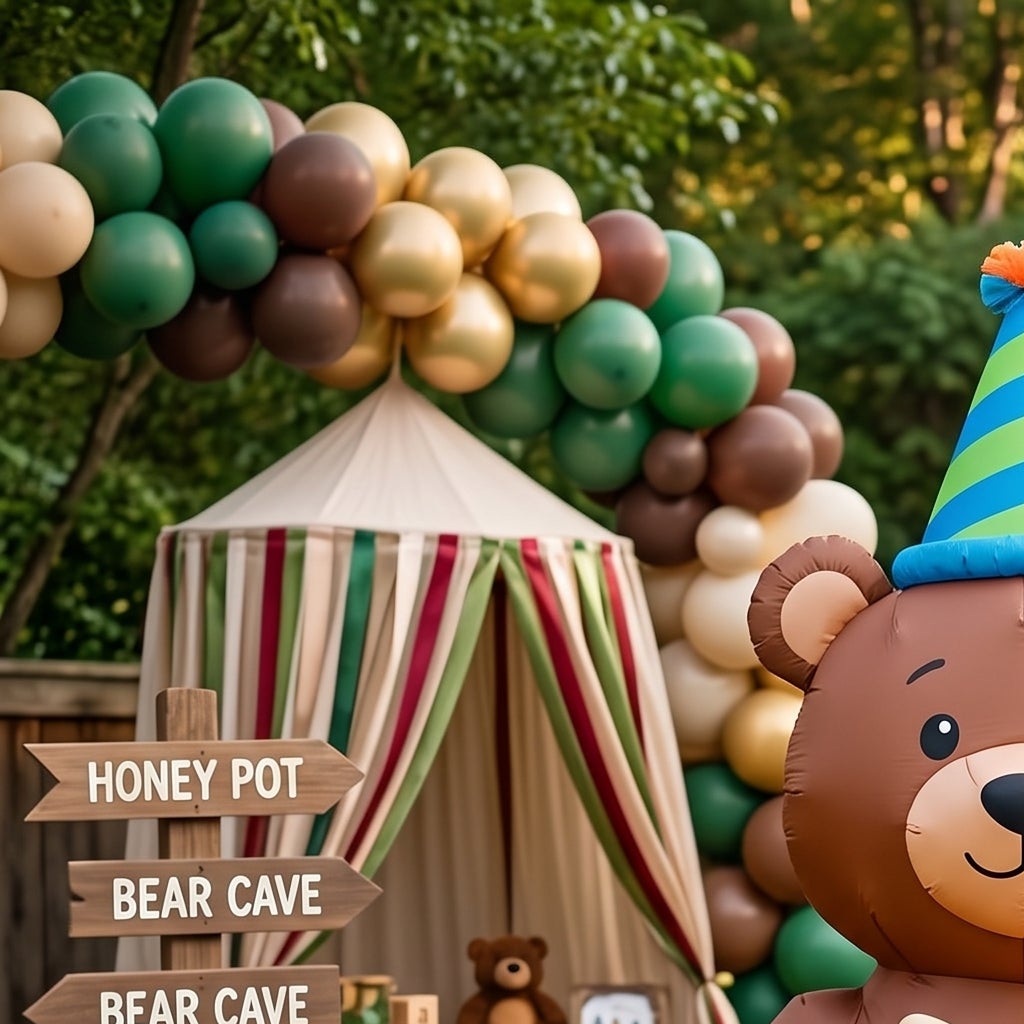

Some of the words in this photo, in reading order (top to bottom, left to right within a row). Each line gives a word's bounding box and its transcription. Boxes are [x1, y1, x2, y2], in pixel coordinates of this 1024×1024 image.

[88, 759, 217, 803] HONEY
[231, 757, 304, 799] POT
[113, 876, 213, 920] BEAR
[227, 873, 322, 917] CAVE
